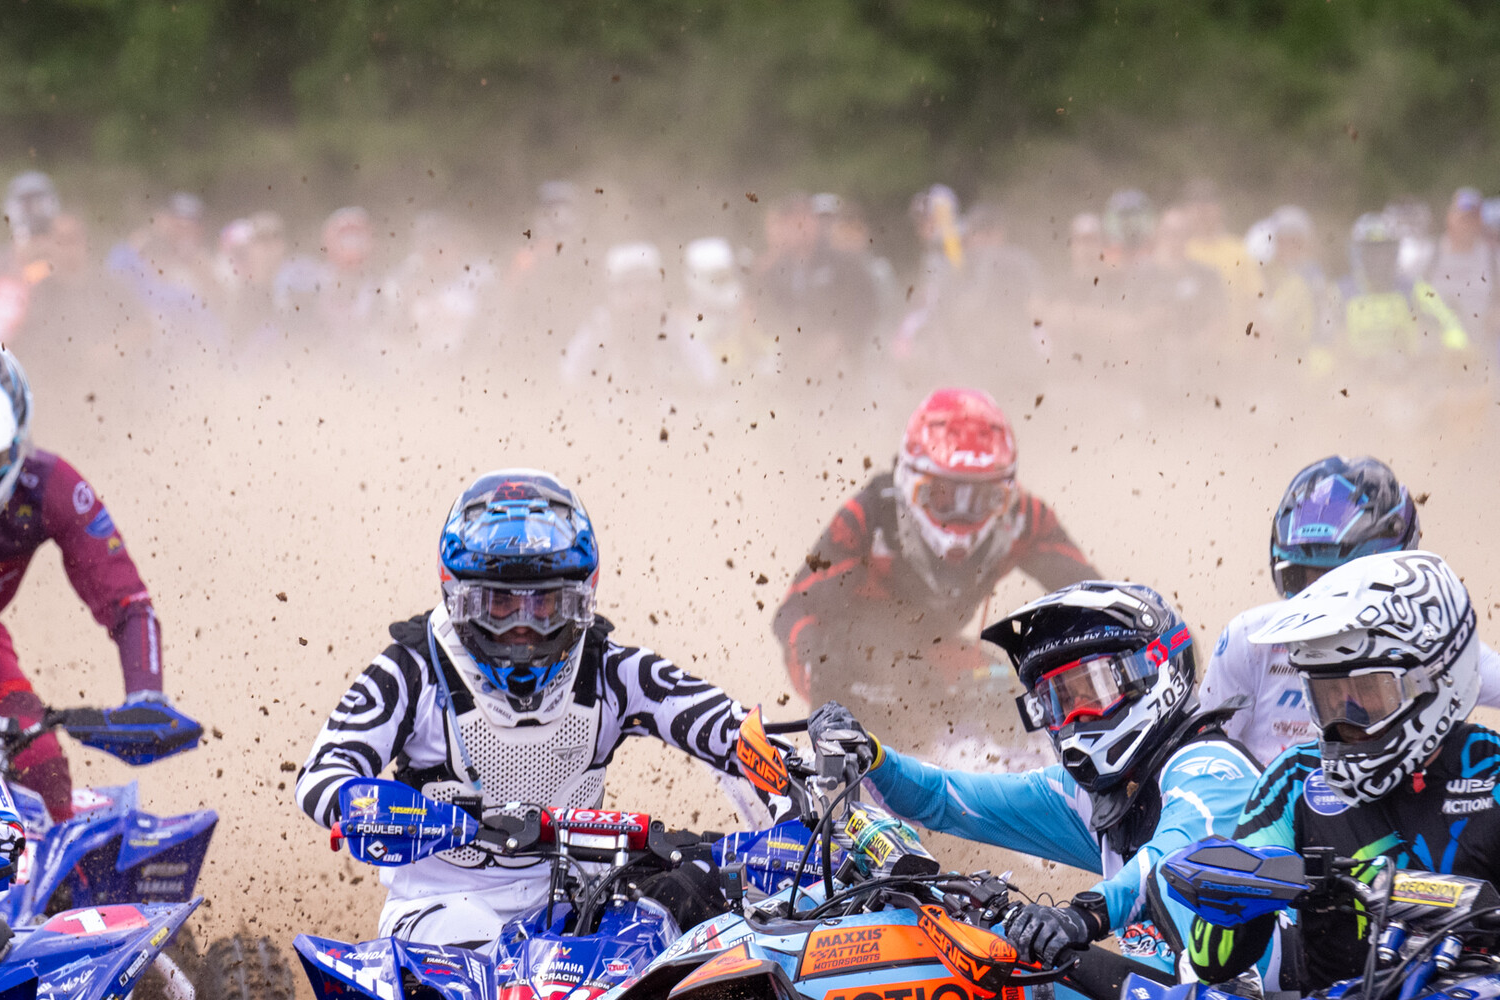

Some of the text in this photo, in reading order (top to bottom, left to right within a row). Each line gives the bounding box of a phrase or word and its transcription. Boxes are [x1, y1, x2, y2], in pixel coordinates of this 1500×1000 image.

[1445, 776, 1496, 794] WPS
[1443, 797, 1493, 815] ACTION
[552, 807, 640, 825] flexx
[356, 823, 403, 835] FOWLER
[785, 860, 825, 876] FOWLE
[63, 907, 108, 934] 1
[815, 927, 882, 950] MAXXIS
[344, 949, 388, 961] KENDA
[826, 941, 880, 961] ATTICA
[812, 952, 882, 972] MOTORSPORTS
